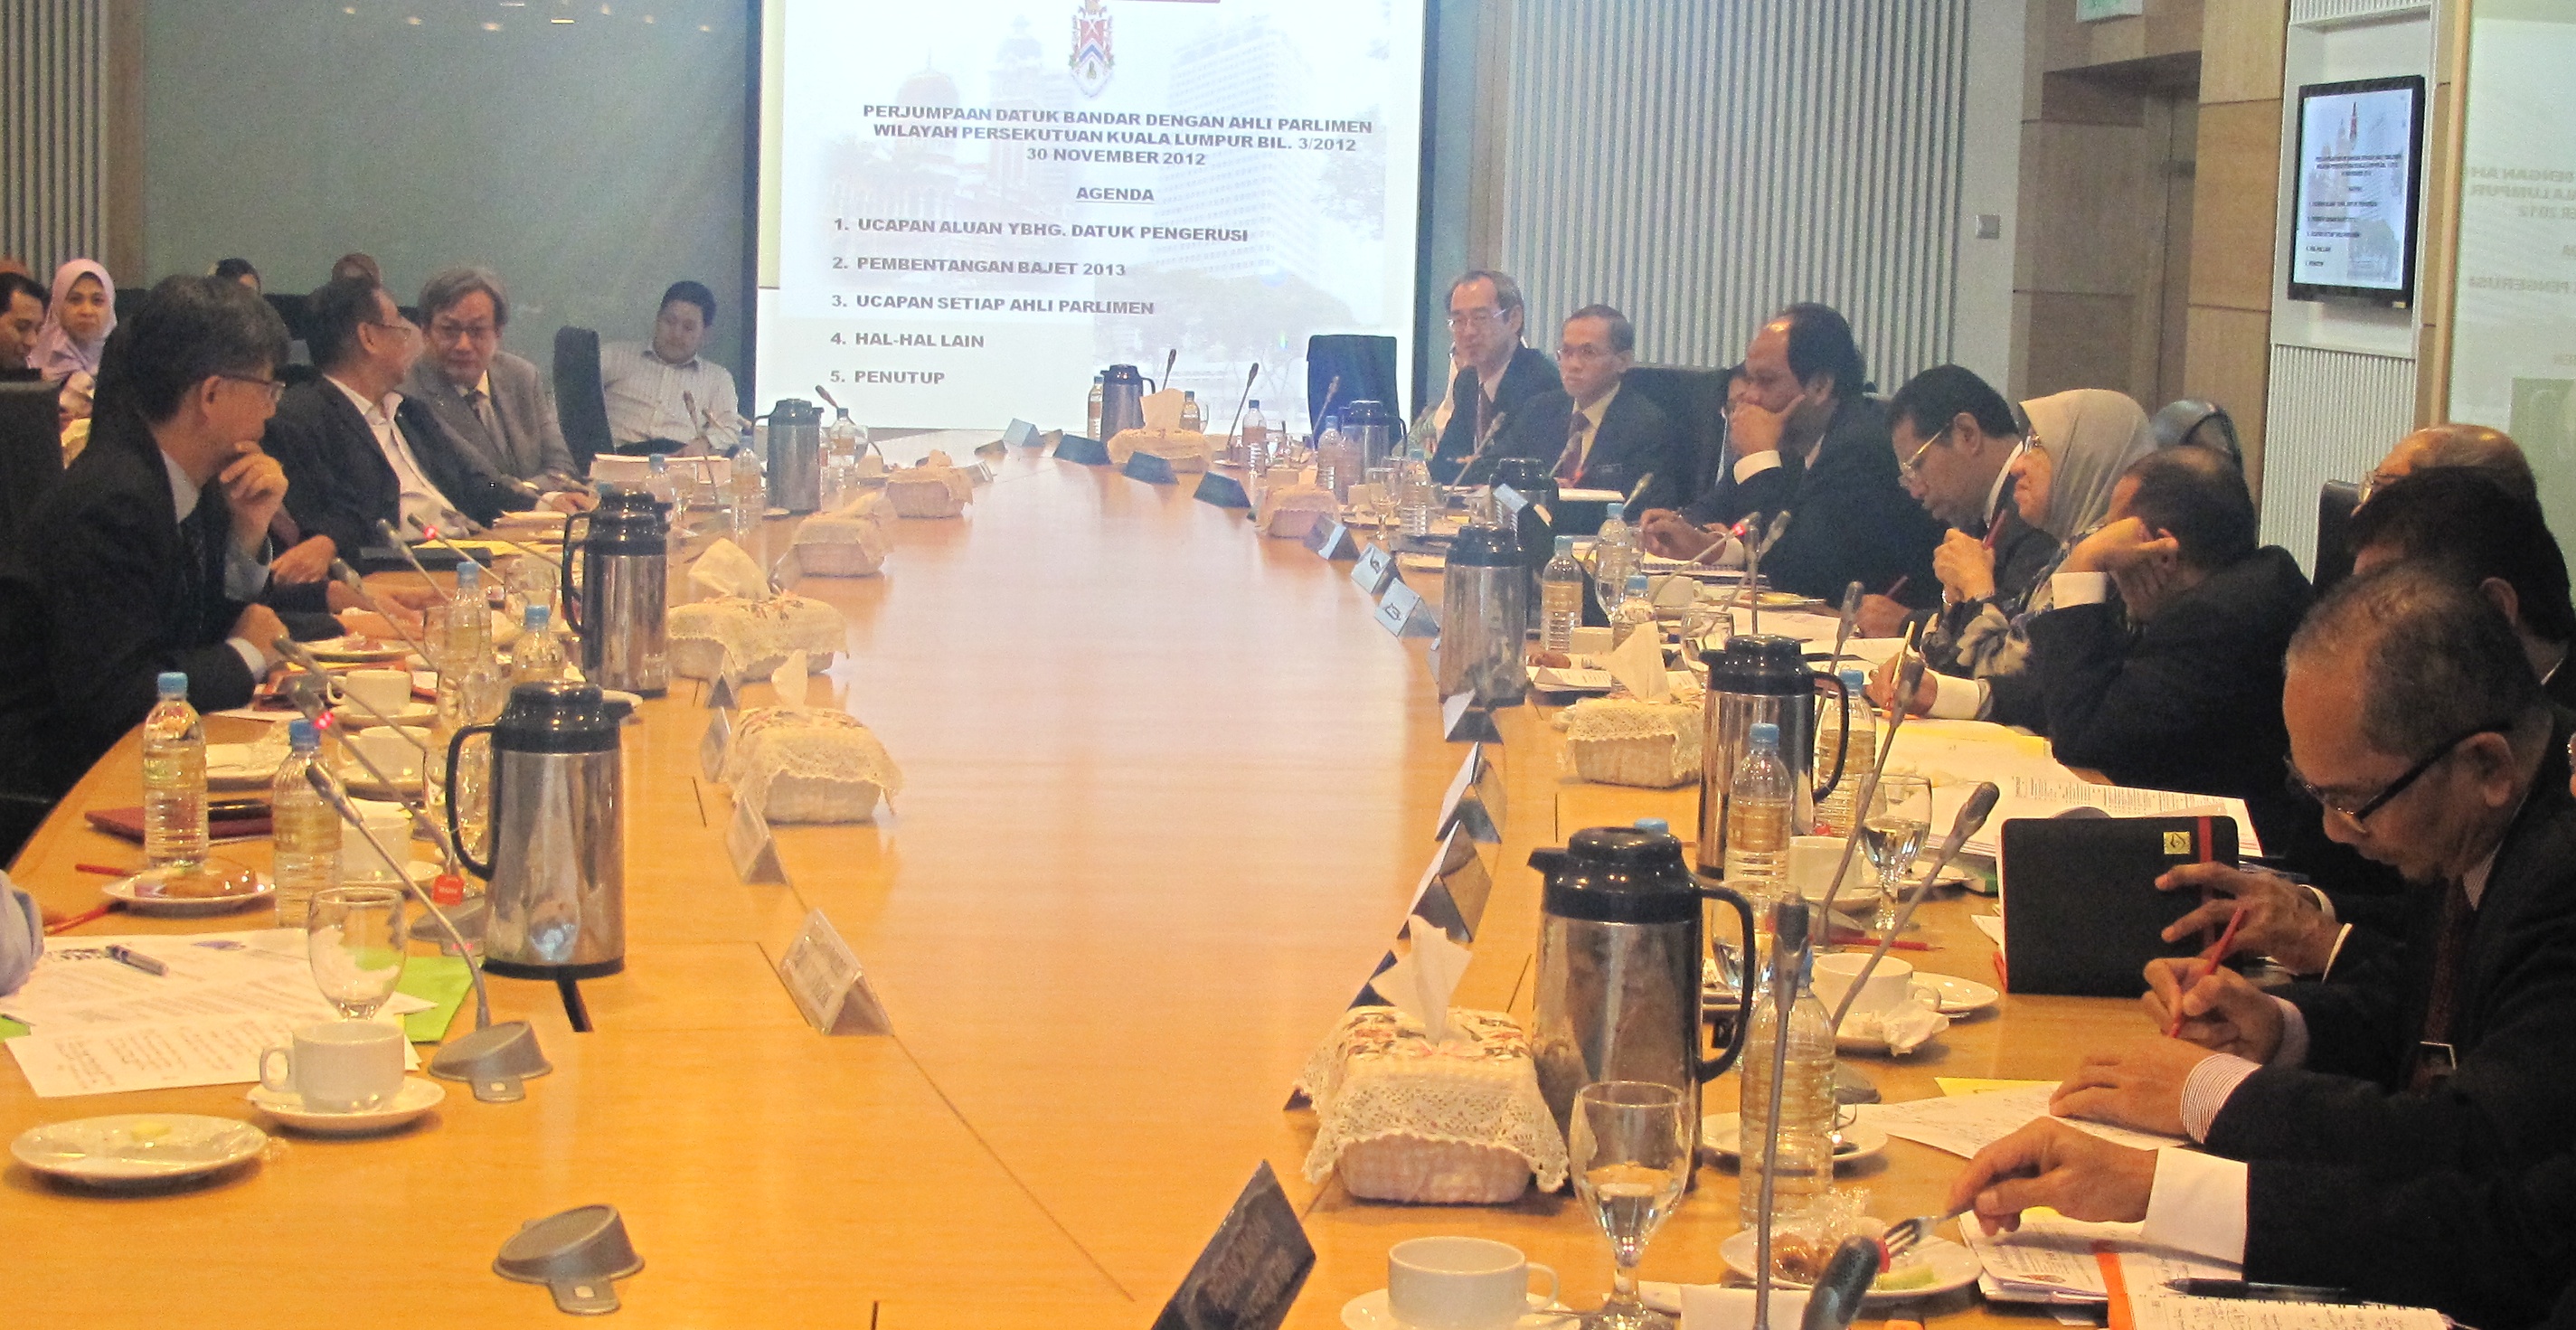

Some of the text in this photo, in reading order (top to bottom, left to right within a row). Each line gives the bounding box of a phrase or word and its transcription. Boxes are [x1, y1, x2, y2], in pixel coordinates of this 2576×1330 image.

[863, 105, 1372, 134] PERJUMPAAN DATUK BANDAR DENGAN AHLI PARLIMEN
[873, 124, 1355, 151] WILAYAH PERSEKUTUAN KUALA LUMPUR BIL. 3/2012
[1027, 148, 1205, 165] 30 NOVEMBER 2012
[1076, 187, 1155, 201] AGENDA
[835, 218, 1248, 241] 1. UCAPAN ALUAN YBHG. DATUK PENGERUSI
[833, 257, 1126, 276] 2. PEMBENTANGAN BAJET 2013
[832, 295, 1155, 314] 3. UCAPAN SETIAP AHLI PARLIMEN
[830, 333, 984, 347] 4. HAL-HAL LAIN
[830, 371, 945, 384] 5. PENUTUP
